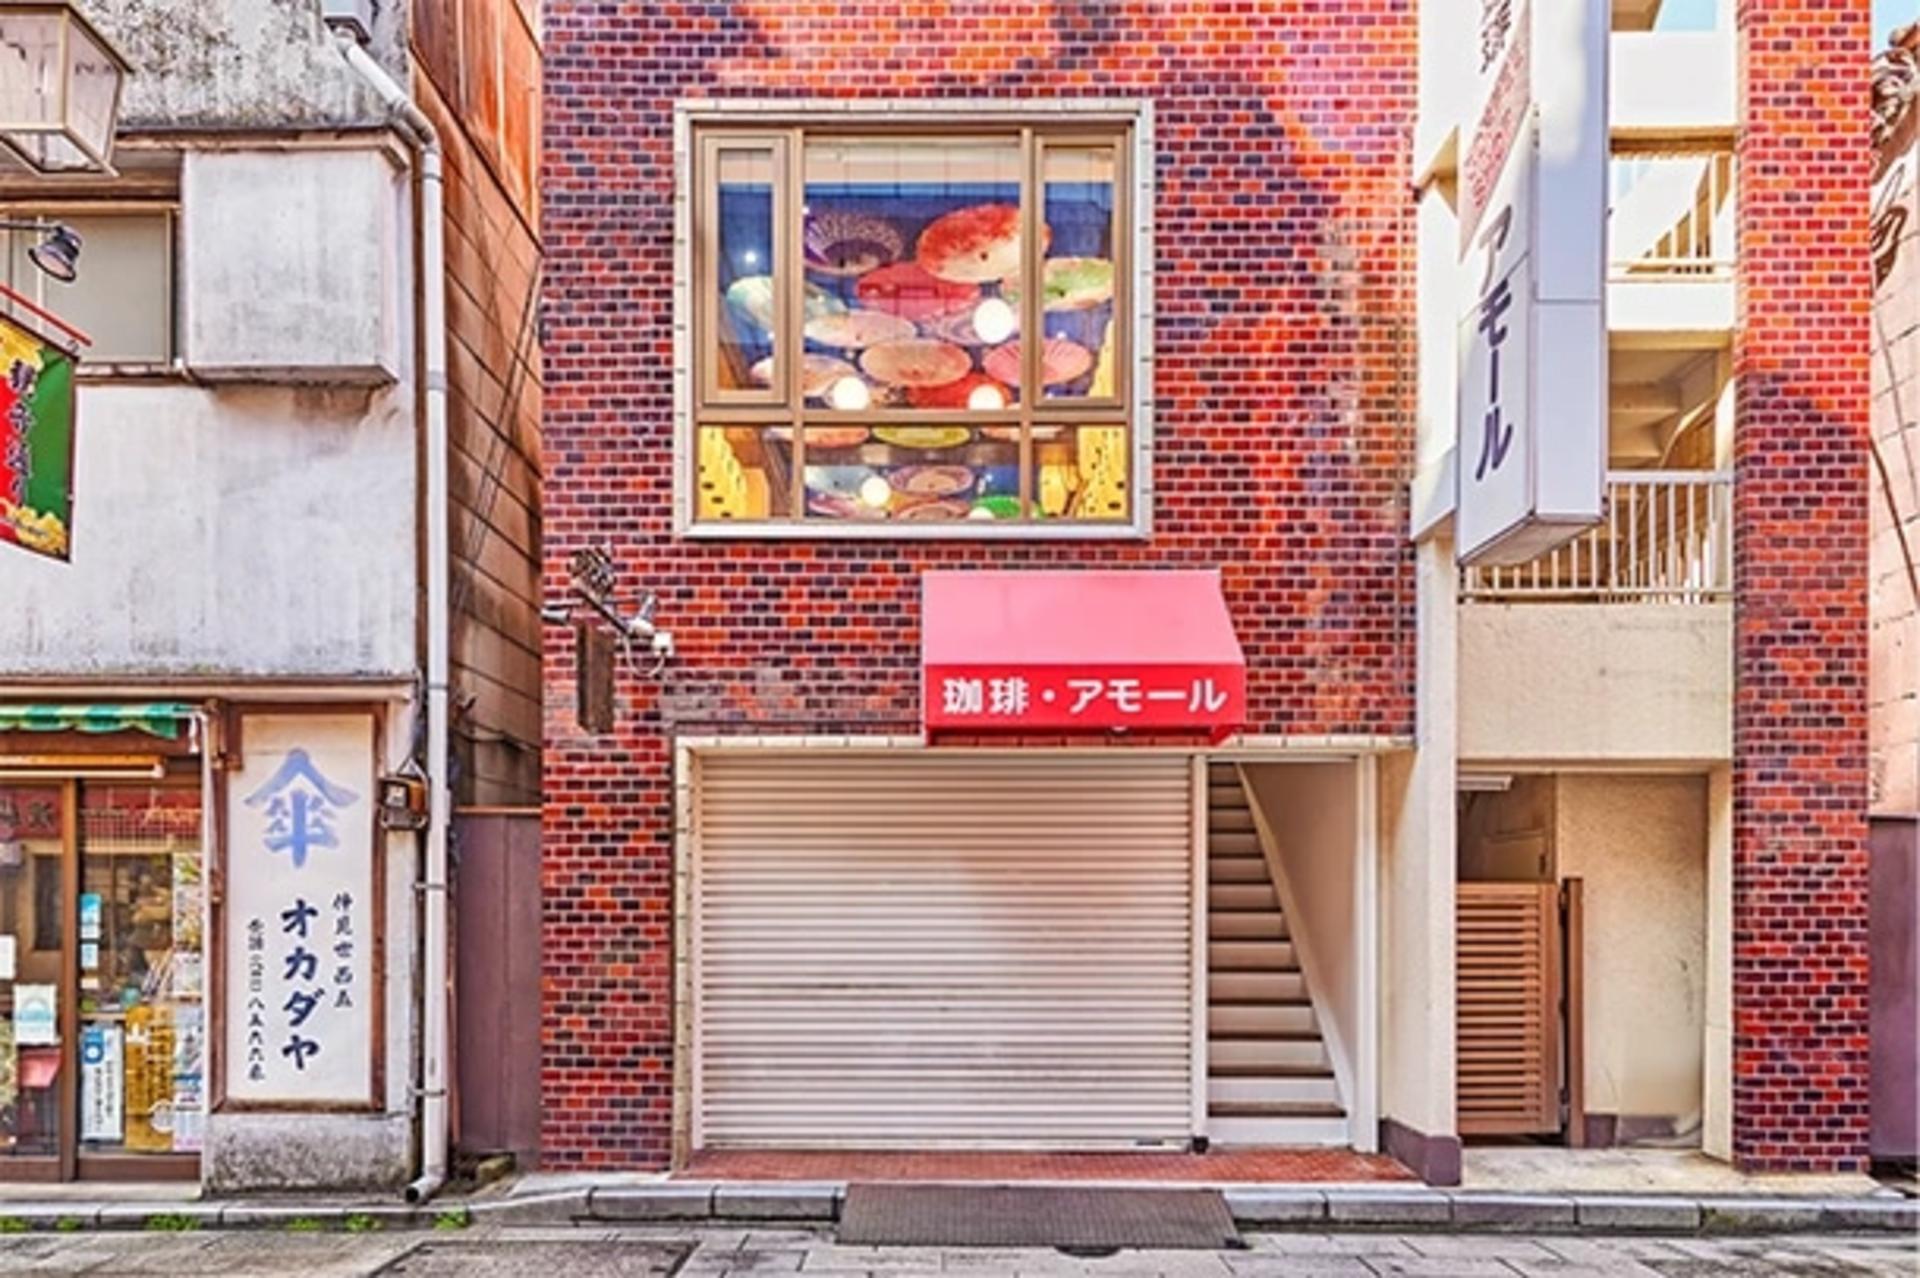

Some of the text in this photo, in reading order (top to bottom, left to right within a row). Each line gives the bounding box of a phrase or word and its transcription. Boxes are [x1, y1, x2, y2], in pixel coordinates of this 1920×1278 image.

[1475, 205, 1512, 481] アモール
[943, 677, 1228, 714] 珈琲・アモール
[280, 900, 326, 1071] オカダヤ
